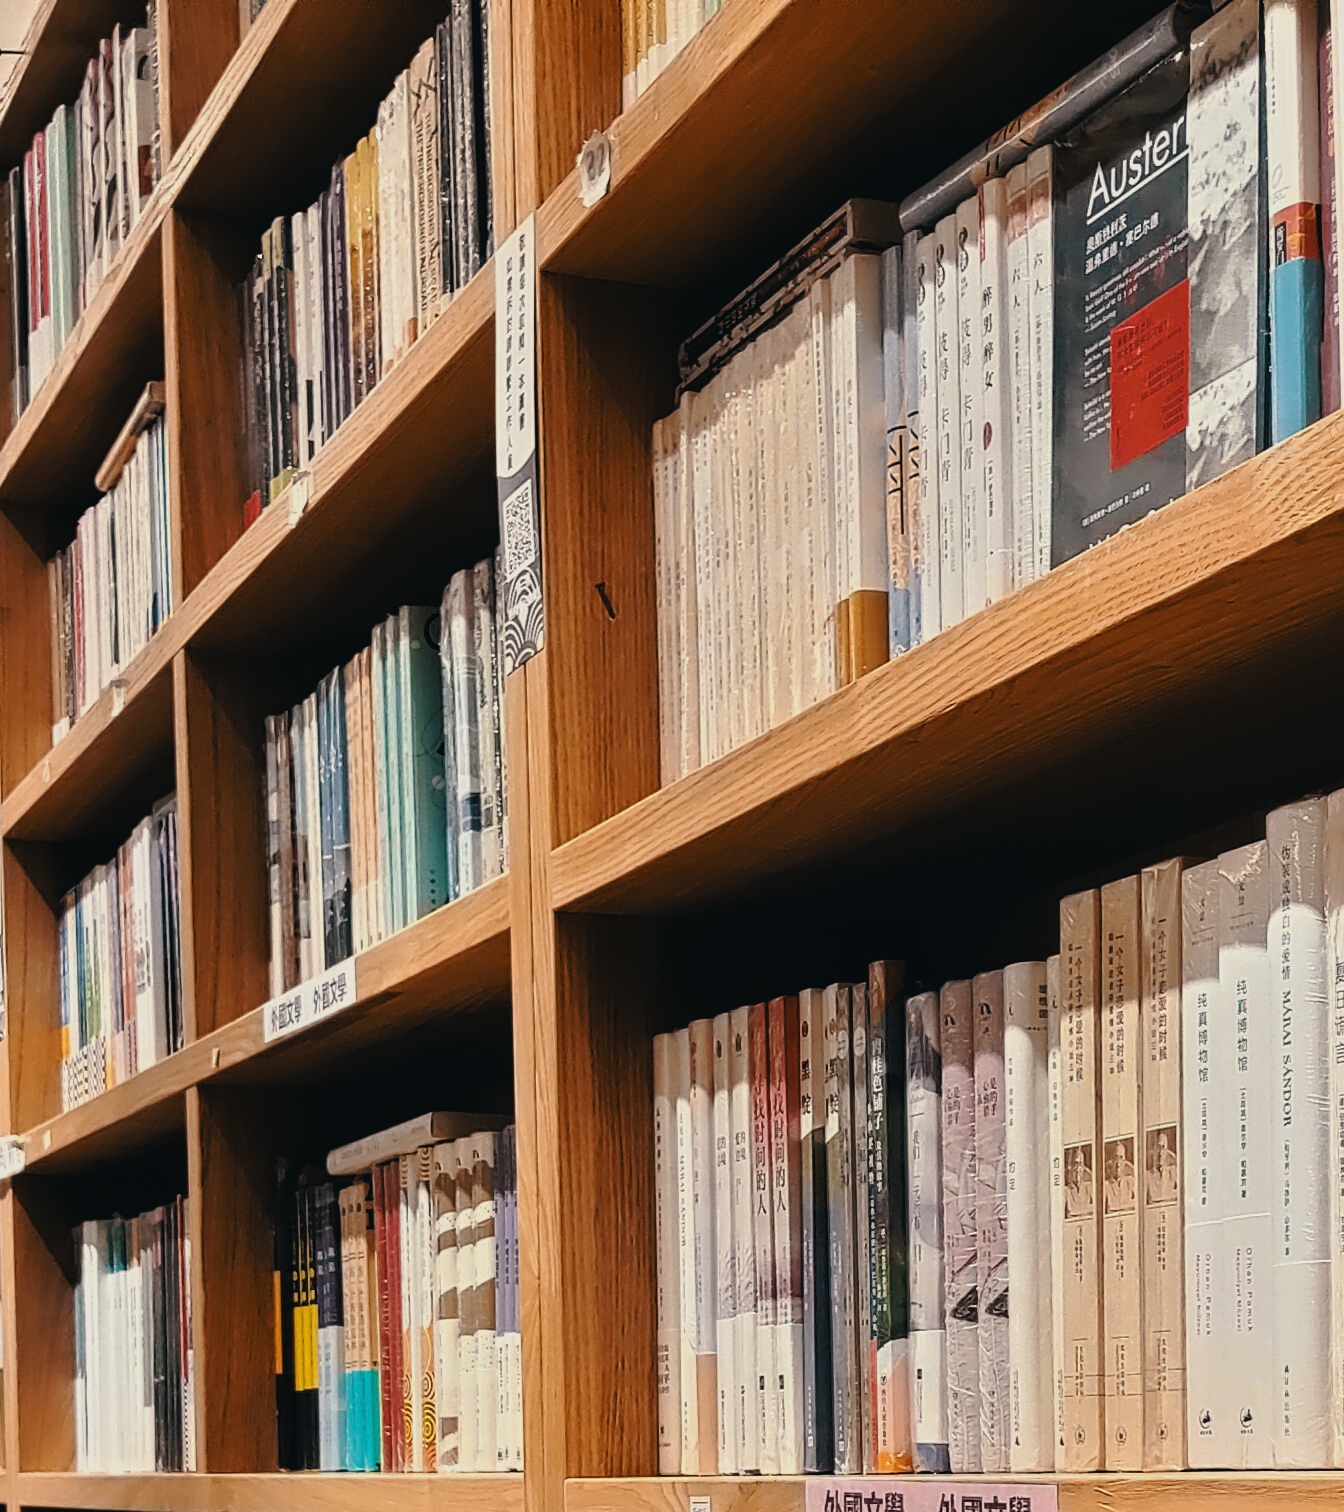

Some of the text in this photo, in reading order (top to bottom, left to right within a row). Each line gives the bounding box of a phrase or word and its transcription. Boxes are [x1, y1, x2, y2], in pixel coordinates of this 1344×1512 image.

[1086, 114, 1186, 218] Auster
[1011, 266, 1023, 309] 六人
[1033, 250, 1045, 296] 六人
[981, 284, 994, 391] 醉男醉女
[938, 330, 952, 483] 彼得·卡门青
[960, 318, 975, 471] 彼得·卡门青
[1280, 843, 1293, 981] 伪装成独白的爱情
[271, 972, 347, 1034] 外國文學 外國文學
[1197, 992, 1210, 1083] 纯真博物馆
[1235, 978, 1249, 1073] 纯真博物馆
[773, 1071, 788, 1213] 寻找时间的人
[1205, 1296, 1213, 1337] Pamuk
[1244, 1247, 1255, 1333] Orhan Pamuk
